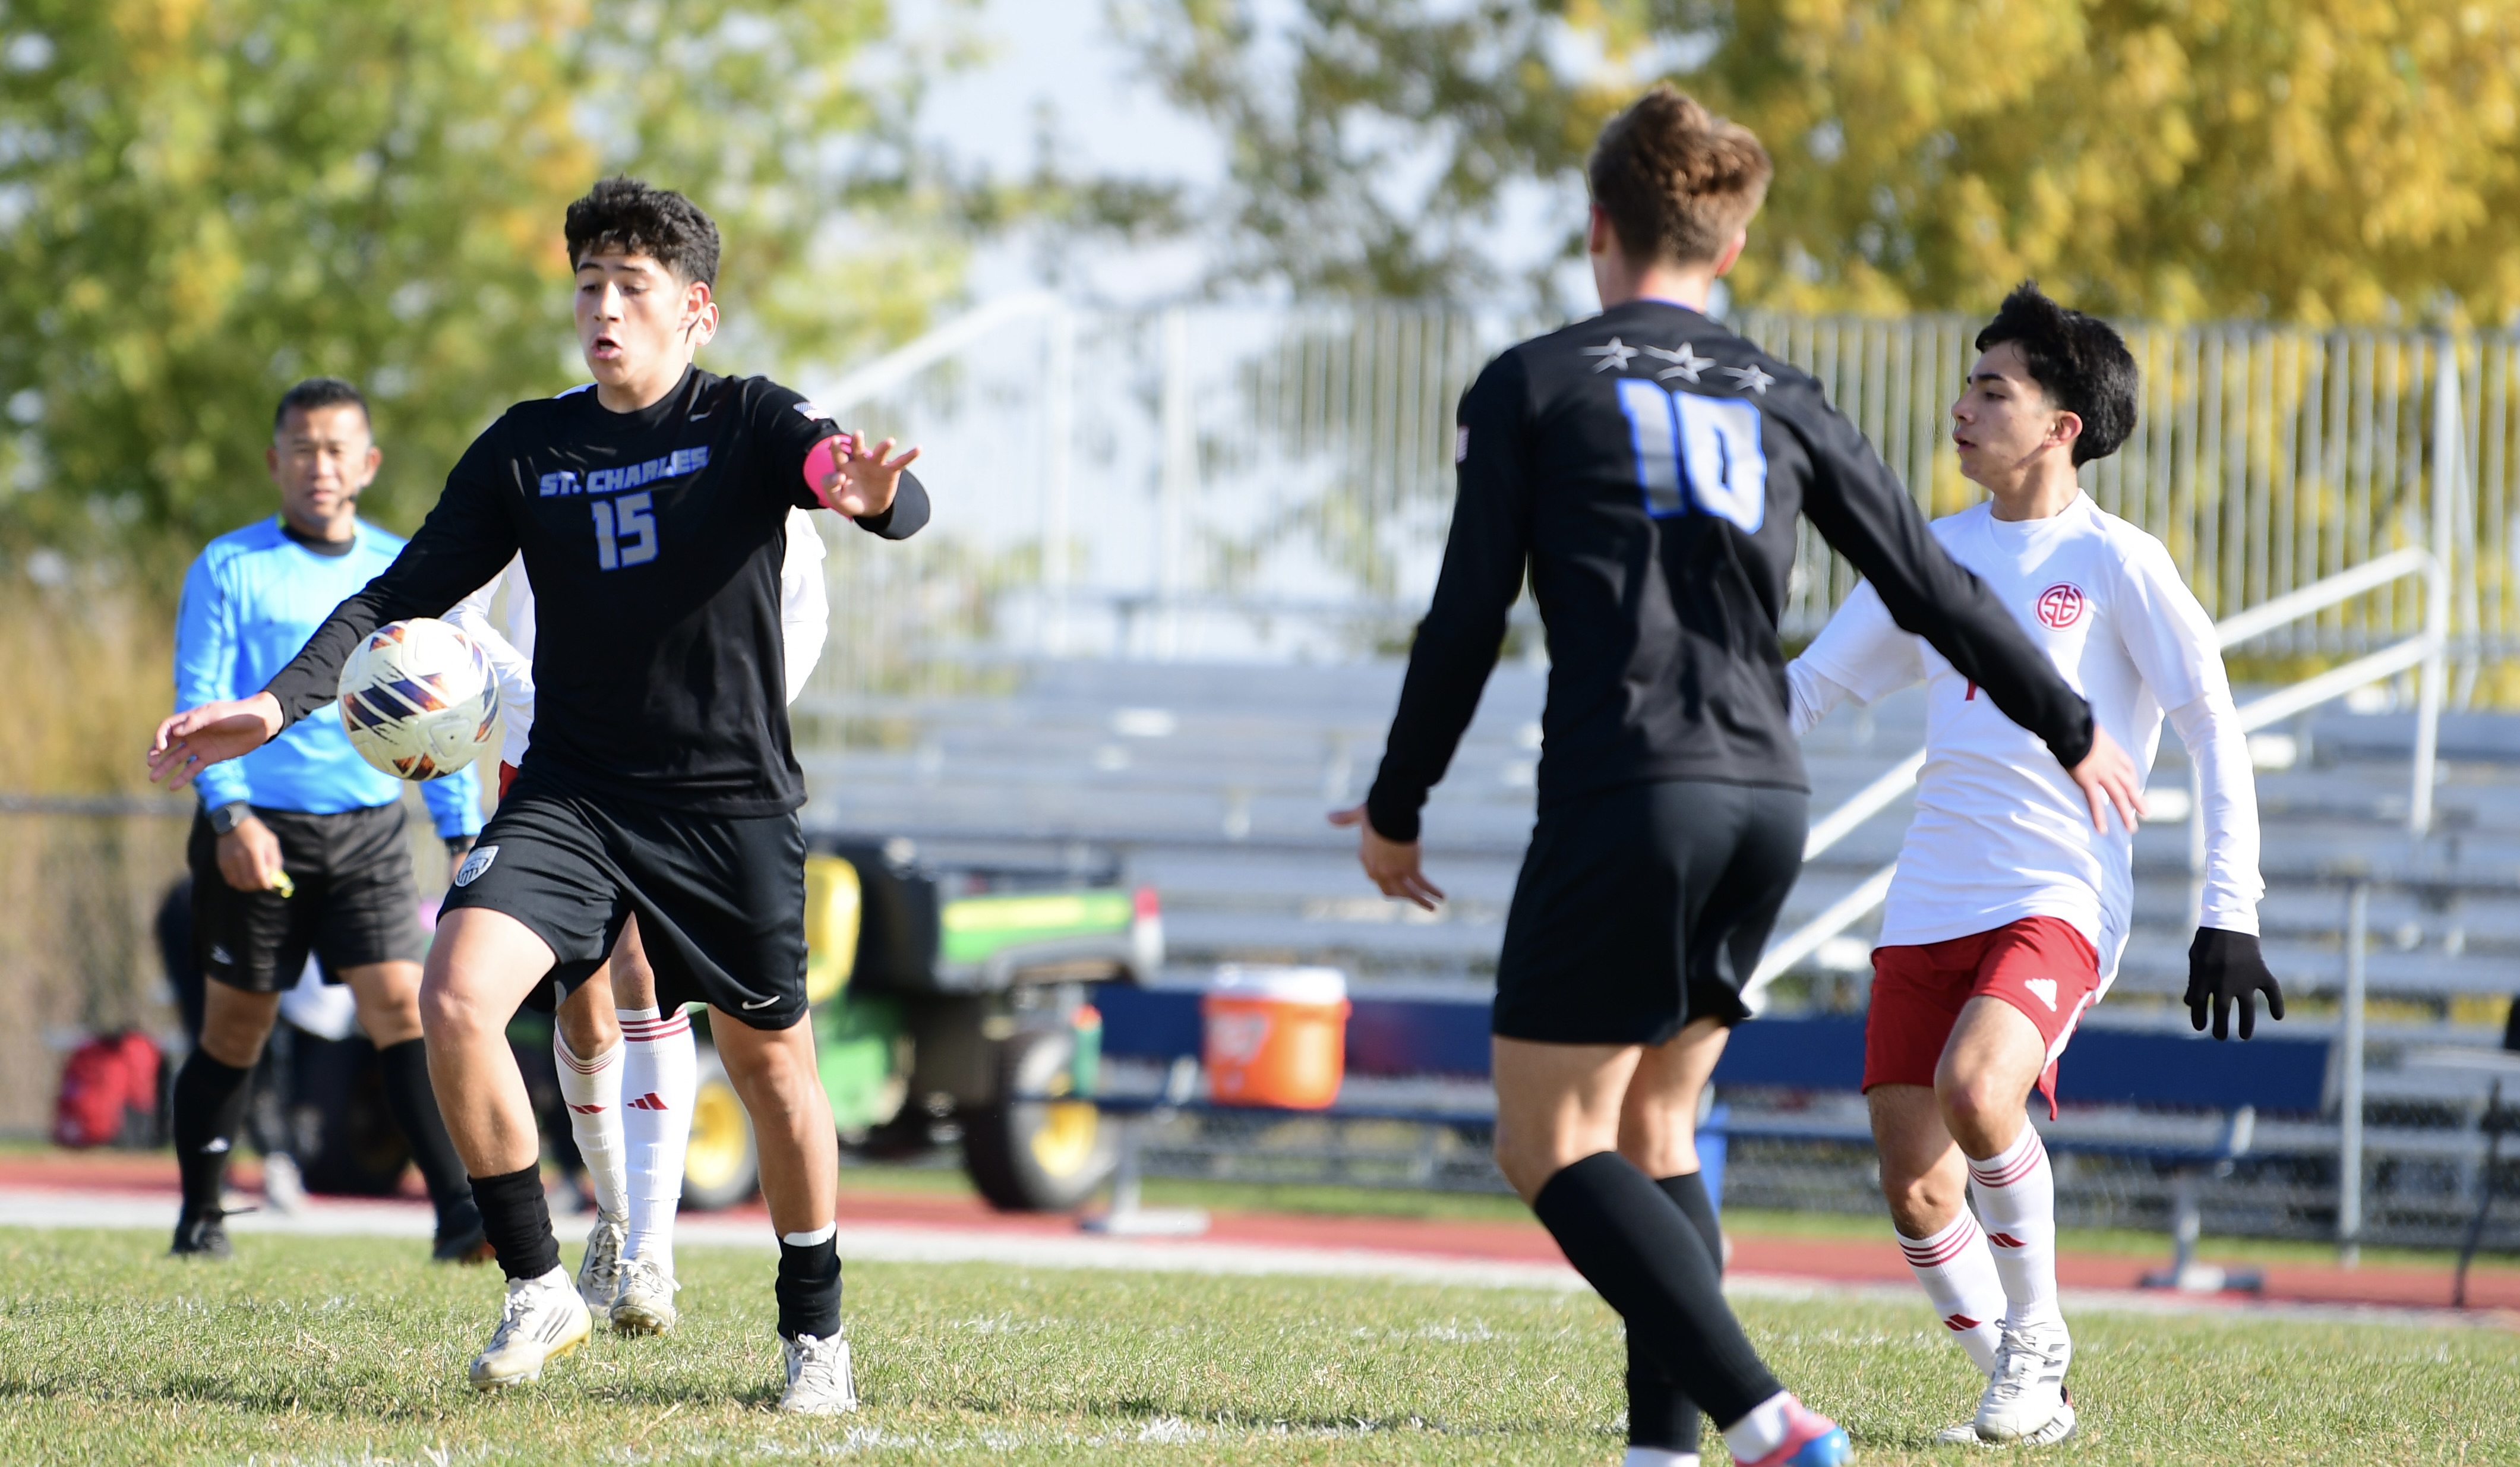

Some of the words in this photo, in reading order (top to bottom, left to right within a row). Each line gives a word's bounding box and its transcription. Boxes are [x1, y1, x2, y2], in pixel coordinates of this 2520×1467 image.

[539, 471, 582, 497] ST.
[586, 445, 709, 494] CHARLES
[1615, 377, 1768, 535] 10
[590, 490, 659, 572] 15
